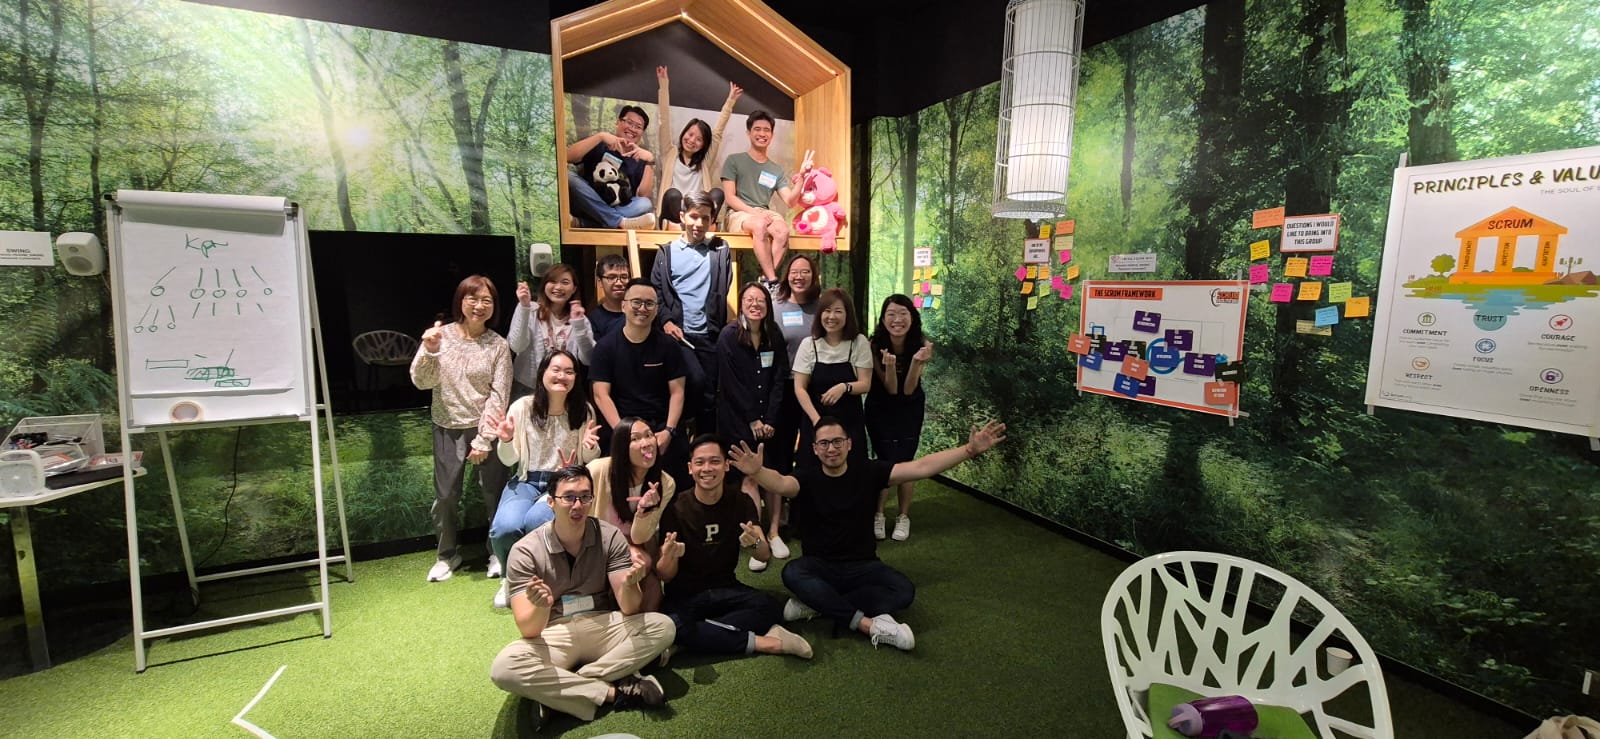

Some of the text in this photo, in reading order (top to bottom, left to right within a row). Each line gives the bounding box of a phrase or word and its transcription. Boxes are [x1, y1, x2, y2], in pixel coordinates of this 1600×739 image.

[1413, 172, 1524, 195] PRINCIPLES
[1529, 170, 1545, 185] &
[1487, 218, 1534, 230] SCRUM
[1104, 289, 1122, 297] SCRUM
[1474, 314, 1505, 322] TRUST
[1402, 328, 1448, 337] COMMITMENT
[1541, 333, 1576, 342] COURAGE
[1405, 372, 1433, 381] RESPECT
[1529, 385, 1570, 395] OPENNESS
[705, 524, 719, 542] P
